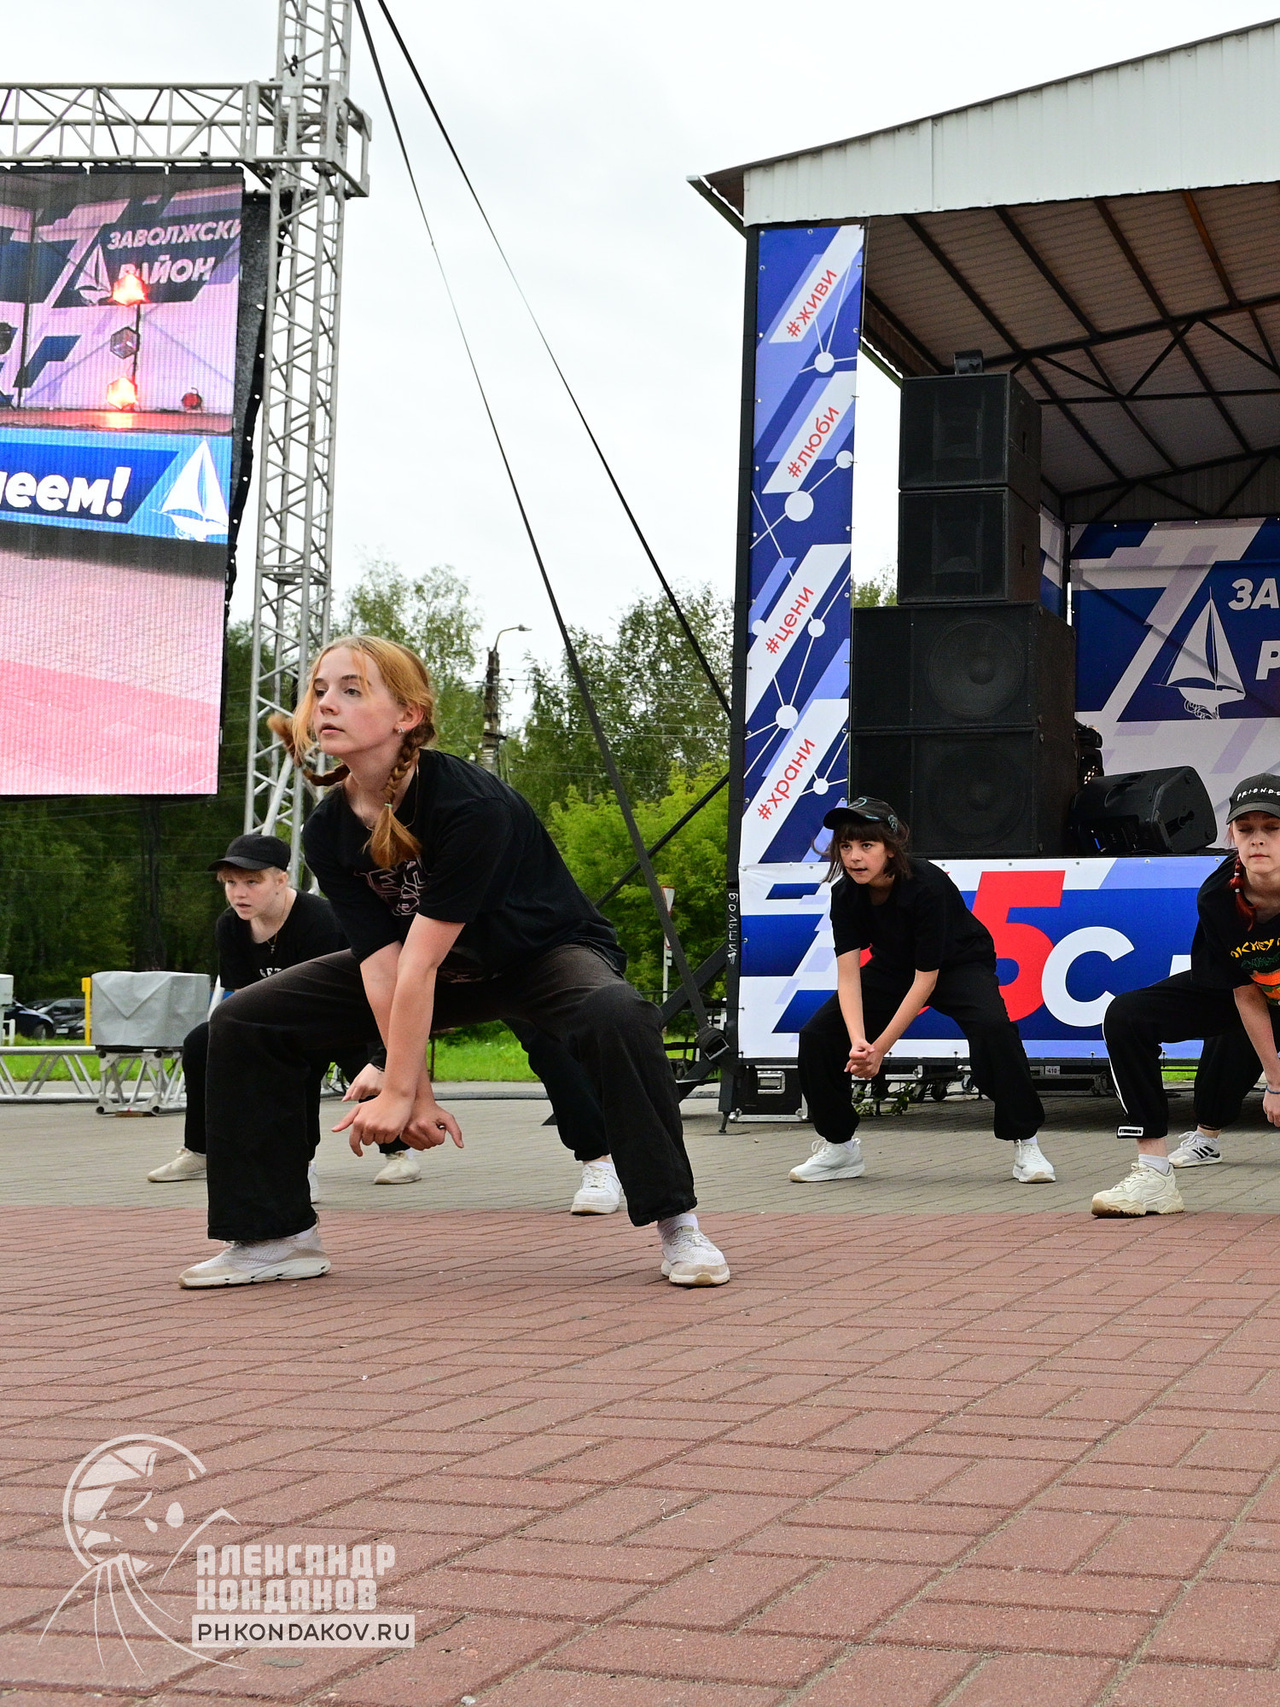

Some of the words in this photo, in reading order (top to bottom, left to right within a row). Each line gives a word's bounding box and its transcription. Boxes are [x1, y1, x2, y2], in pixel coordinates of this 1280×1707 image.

[786, 269, 837, 337] #живи
[787, 406, 840, 478] #люби
[0, 466, 132, 517] еем!
[765, 586, 814, 654] #цени
[757, 738, 816, 820] #храни
